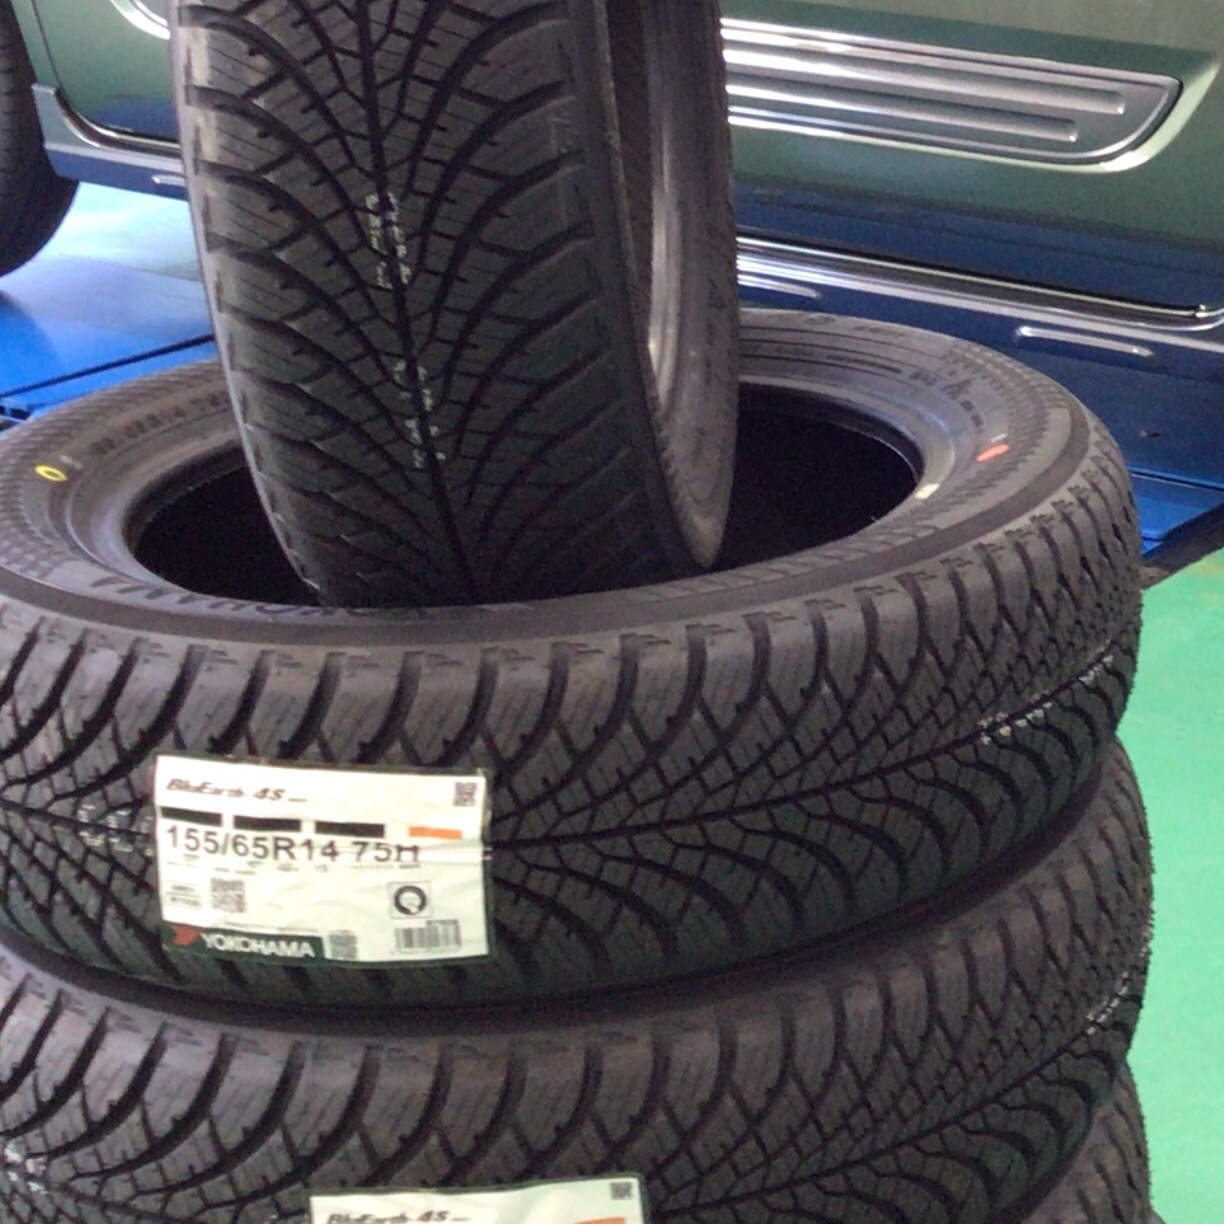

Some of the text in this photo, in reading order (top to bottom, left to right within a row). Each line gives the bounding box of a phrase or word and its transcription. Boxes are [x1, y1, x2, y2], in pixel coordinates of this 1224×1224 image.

[254, 787, 286, 802] 4S
[165, 824, 340, 864] 155/65R14
[352, 840, 421, 863] 75H
[201, 932, 316, 959] YOKOHAMA
